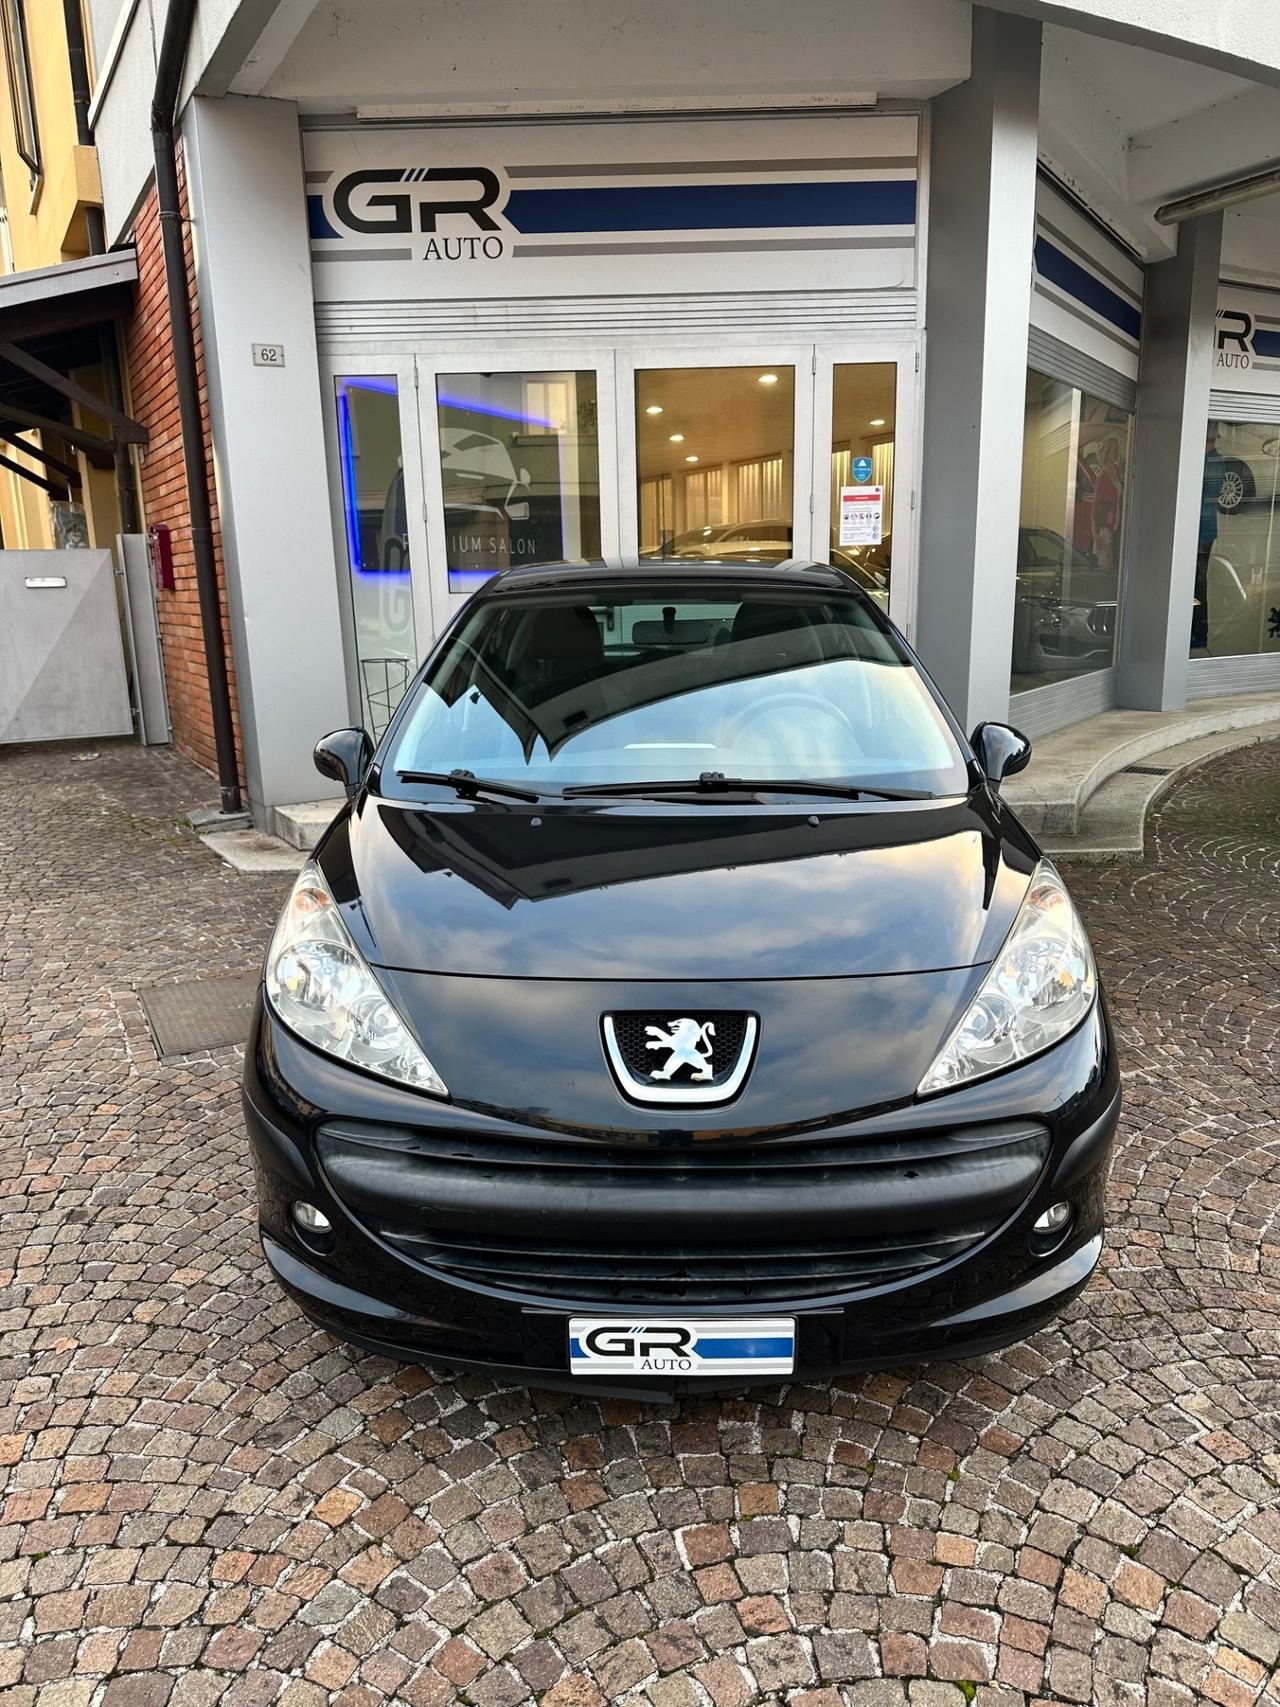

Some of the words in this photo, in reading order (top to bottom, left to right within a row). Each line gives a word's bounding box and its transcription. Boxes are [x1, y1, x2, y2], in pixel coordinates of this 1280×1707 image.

[333, 167, 502, 234] GR
[423, 236, 503, 260] AUTO
[1213, 308, 1250, 353] R
[261, 348, 277, 361] 62
[1216, 352, 1250, 369] AUTO
[489, 536, 536, 554] SALON
[585, 1326, 692, 1357] GR
[640, 1359, 692, 1370] AUTO
